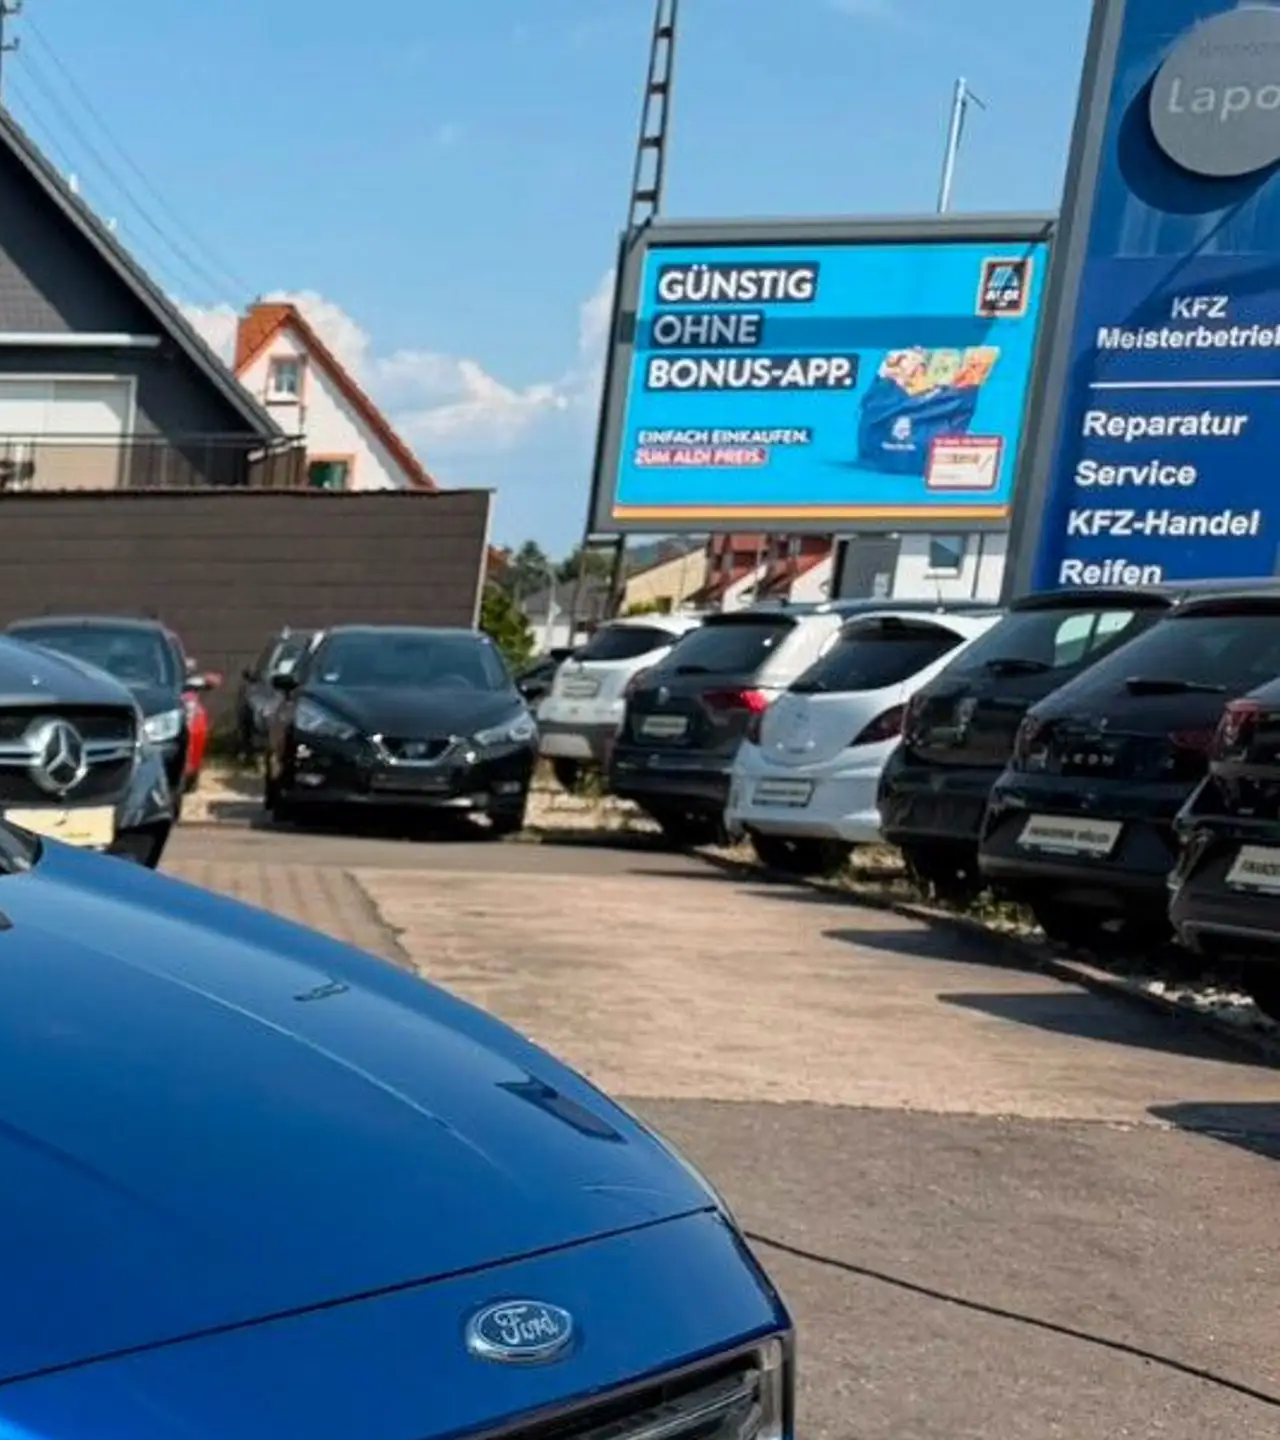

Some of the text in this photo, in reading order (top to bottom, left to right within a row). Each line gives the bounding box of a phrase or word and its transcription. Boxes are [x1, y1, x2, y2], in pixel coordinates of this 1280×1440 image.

[657, 265, 815, 301] GÜNSTIG
[1171, 295, 1228, 319] KFZ
[653, 314, 760, 345] OHNE
[647, 357, 853, 388] BONUS-APP.
[638, 430, 708, 444] EINFACH
[1082, 410, 1248, 442] Reparatur
[1075, 460, 1197, 486] Service
[1067, 508, 1261, 536] KFZ-Handel
[1059, 558, 1162, 585] Reifen
[494, 1306, 559, 1345] Ford
